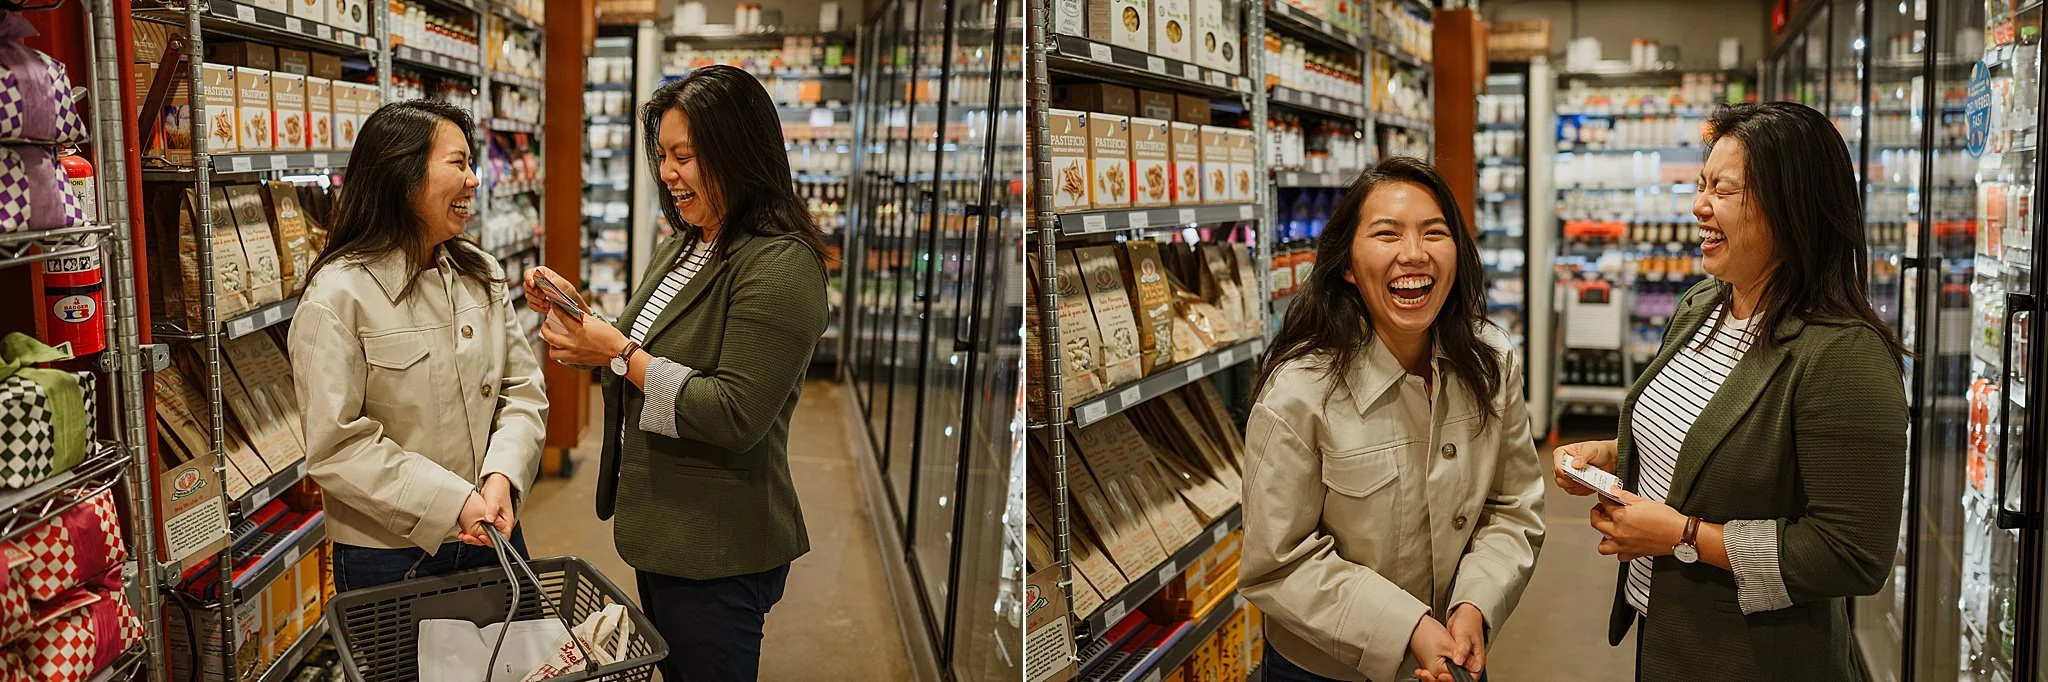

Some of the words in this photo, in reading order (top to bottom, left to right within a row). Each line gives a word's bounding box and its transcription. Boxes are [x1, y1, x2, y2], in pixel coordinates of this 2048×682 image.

[204, 86, 233, 97] PASTIFICIO
[242, 89, 268, 100] PASTIFICIO
[1966, 93, 1990, 115] DELIVERED
[1973, 112, 1983, 127] FAST
[1050, 135, 1086, 147] PASTIFICIO
[1096, 137, 1126, 149] PASTIFICIO
